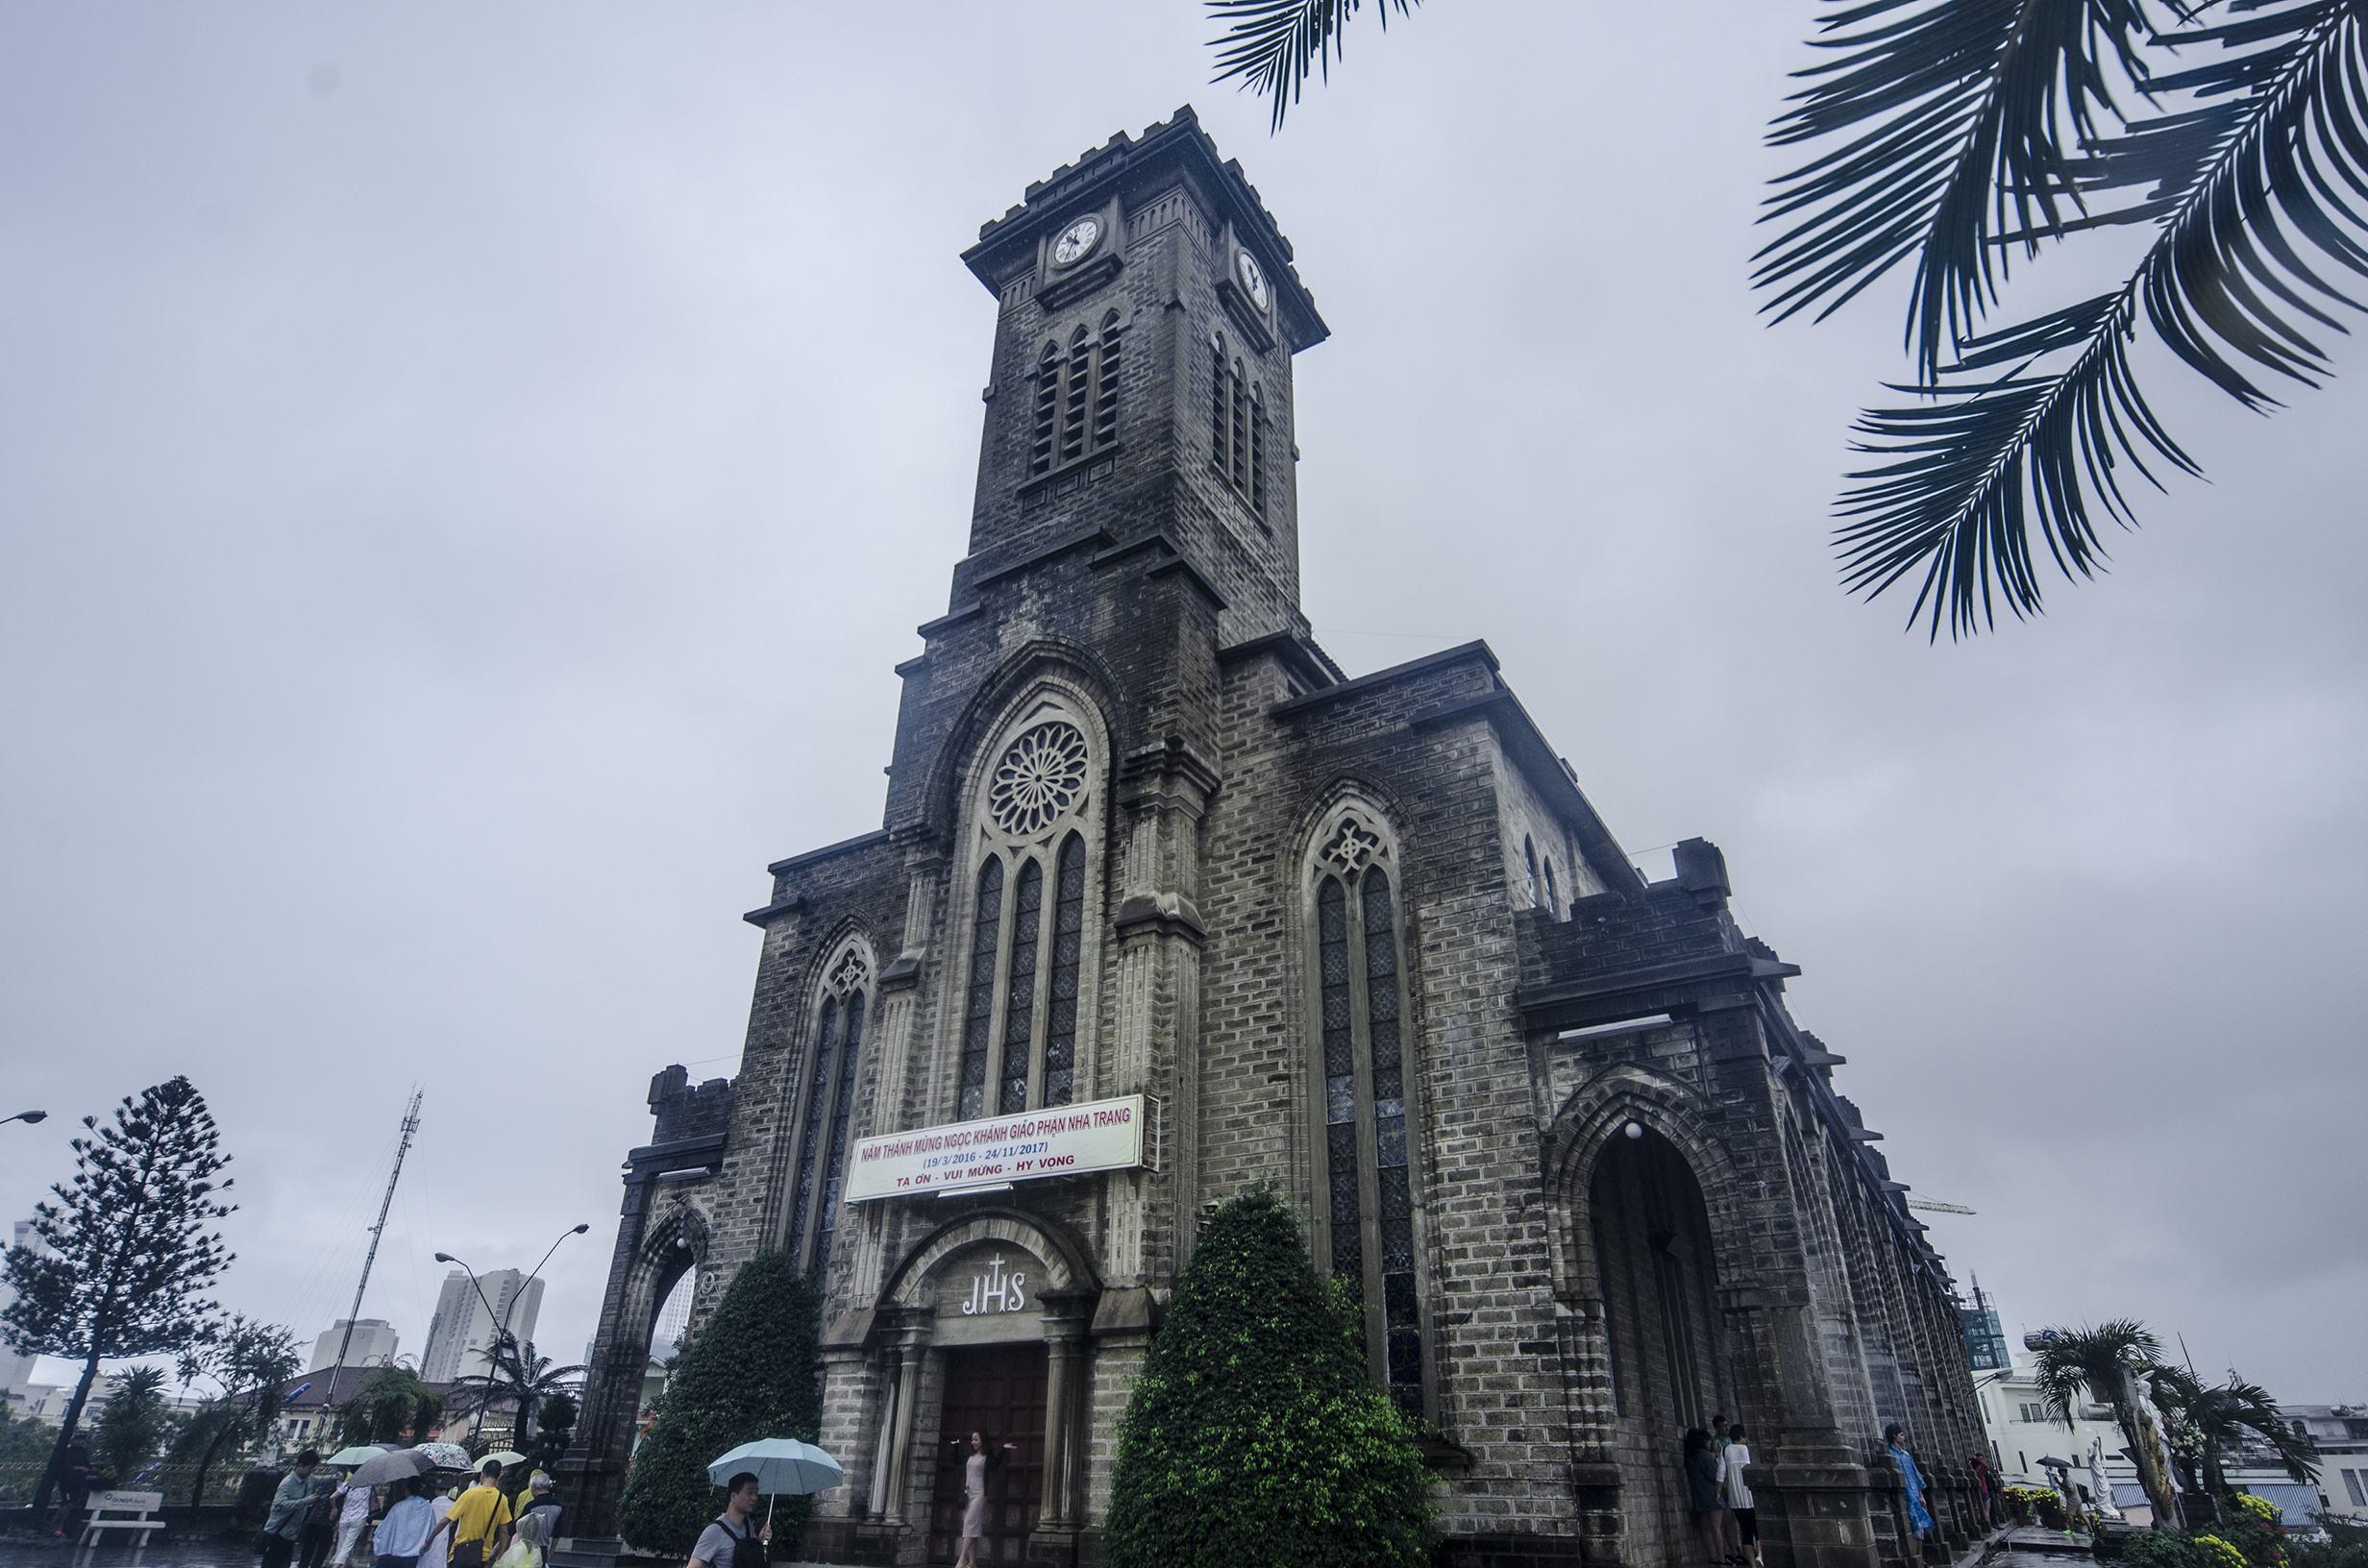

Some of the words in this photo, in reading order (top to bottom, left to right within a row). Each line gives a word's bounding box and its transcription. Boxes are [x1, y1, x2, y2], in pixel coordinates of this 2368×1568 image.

[943, 1131, 972, 1151] NGỌC
[1067, 1114, 1091, 1131] NHA
[1093, 1107, 1131, 1127] TRANG
[923, 1152, 976, 1169] (19/3/2016
[984, 1141, 1048, 1160] 24/11/2017)
[944, 1170, 963, 1181] VUI
[1016, 1160, 1034, 1171] HY
[1039, 1154, 1075, 1170] VỌNG
